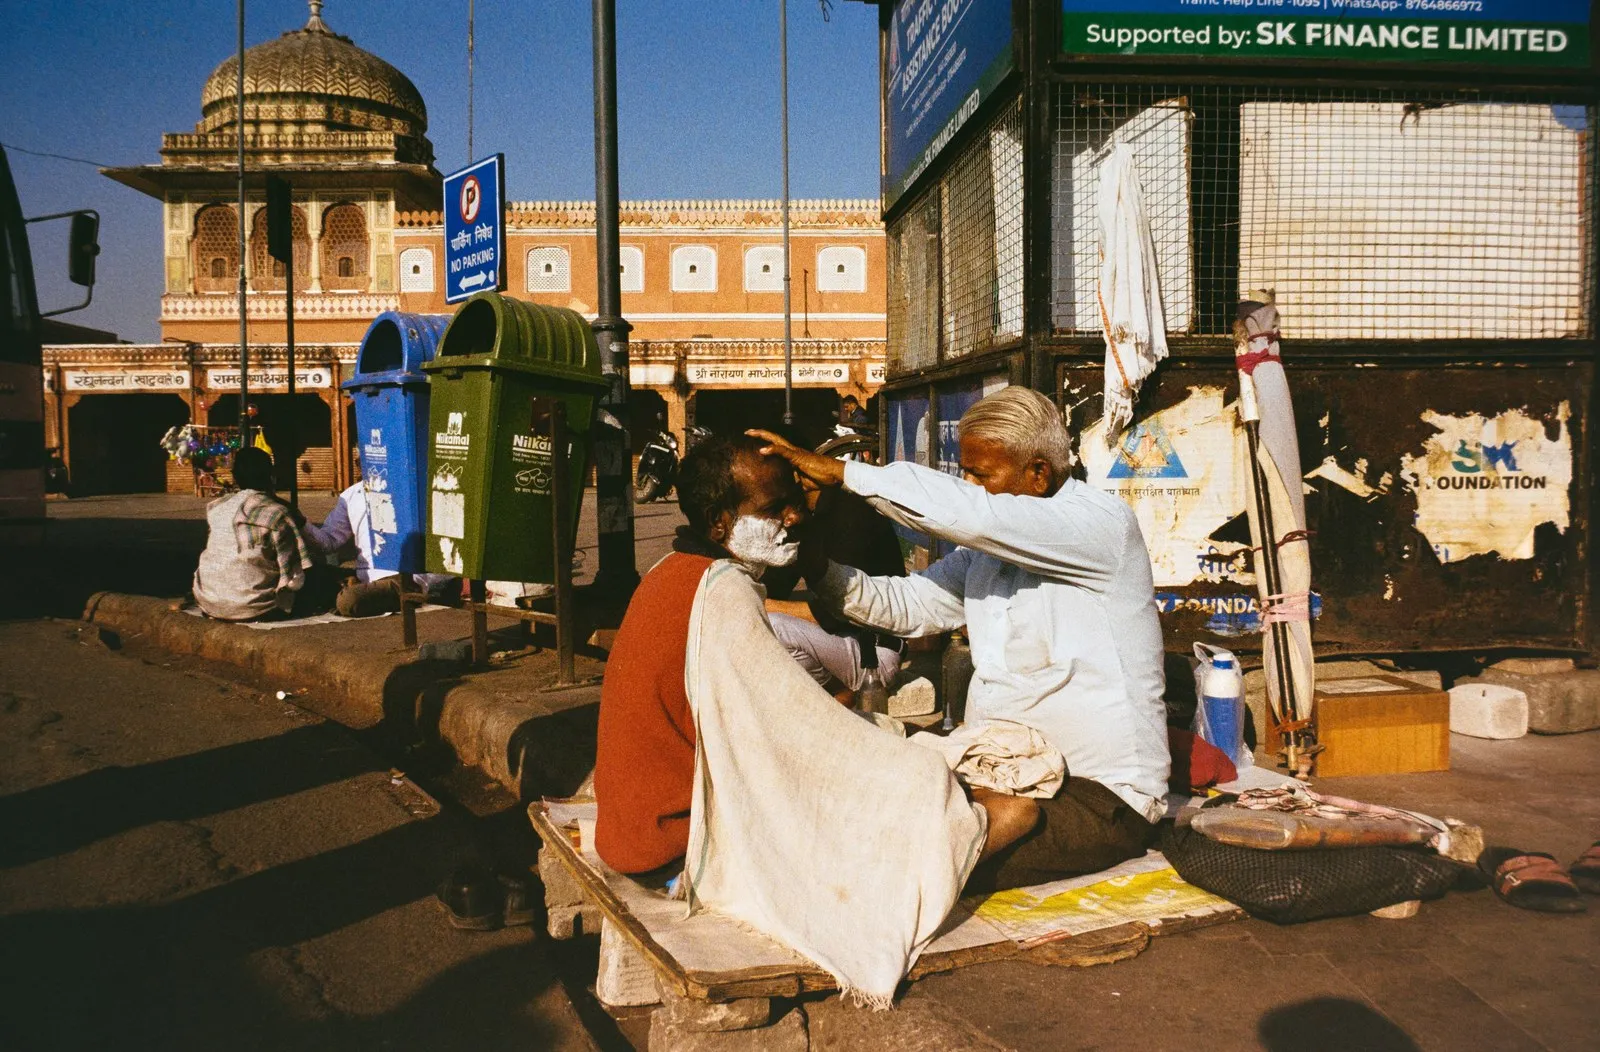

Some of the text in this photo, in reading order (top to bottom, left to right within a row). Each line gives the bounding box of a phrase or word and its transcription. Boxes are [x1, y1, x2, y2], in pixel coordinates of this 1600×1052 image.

[1405, 0, 1483, 12] 8764866972
[1086, 22, 1568, 52] Supported by: SK FINANCE LIMITED
[902, 14, 940, 97] ASSISTANCE
[450, 222, 493, 252] पार्किंग निषेध
[451, 247, 494, 274] NO PARKING
[747, 366, 788, 380] माधोला
[1426, 475, 1547, 490] OUNDATION
